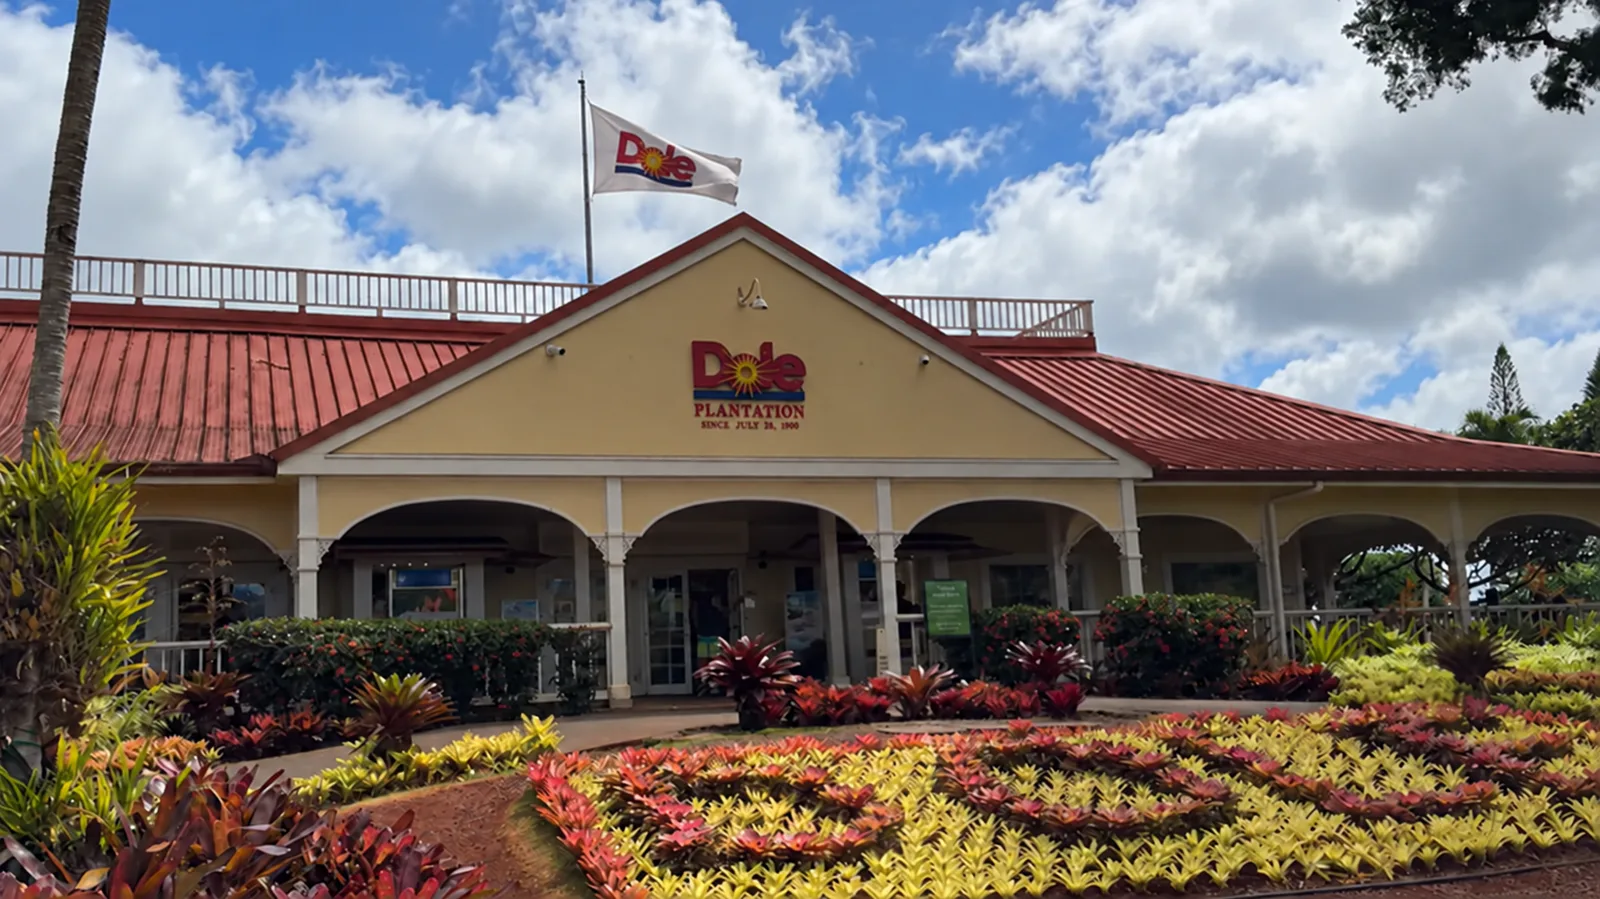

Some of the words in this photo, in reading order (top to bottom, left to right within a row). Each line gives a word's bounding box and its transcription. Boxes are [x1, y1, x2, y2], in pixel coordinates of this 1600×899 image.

[616, 130, 697, 181] Dole
[691, 340, 806, 392] Dole
[694, 403, 804, 419] PLANTATION
[701, 421, 730, 430] SINCE
[735, 421, 760, 430] JULY
